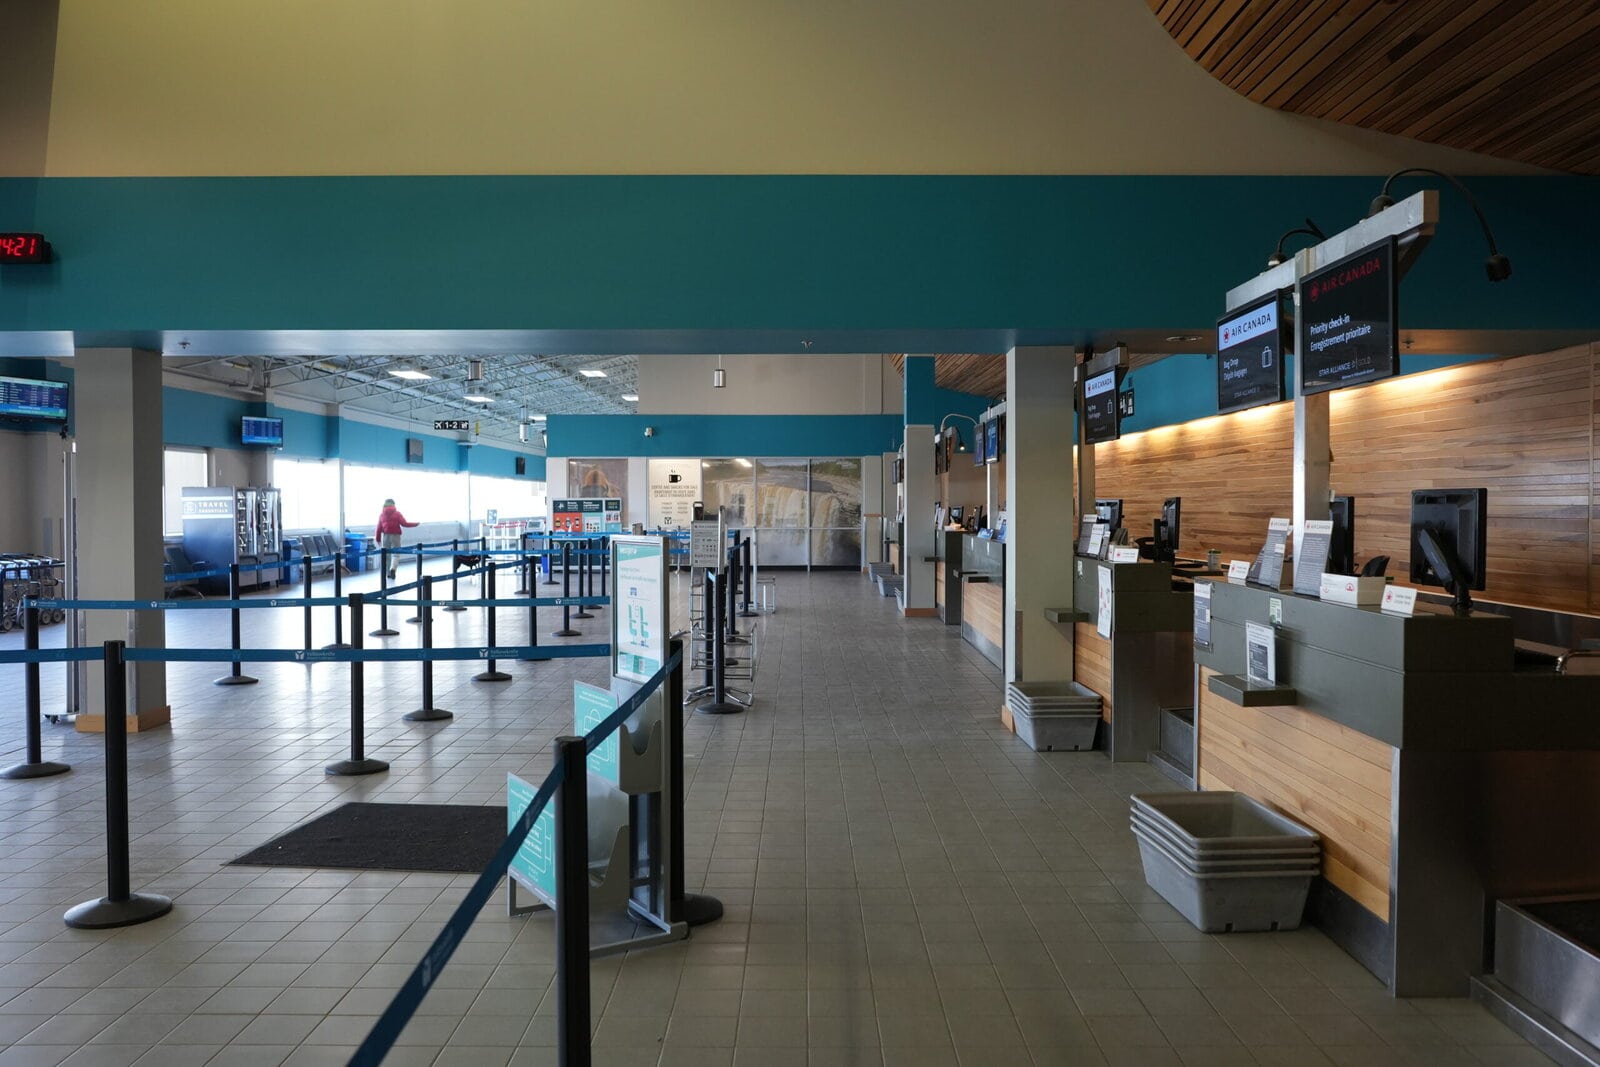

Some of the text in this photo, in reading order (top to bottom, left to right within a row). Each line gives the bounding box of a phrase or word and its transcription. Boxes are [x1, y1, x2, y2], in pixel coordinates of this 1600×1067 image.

[1322, 258, 1380, 293] AIR CANADA
[1231, 313, 1271, 337] AIR CANADA
[1310, 313, 1350, 336] Priority check-in
[1310, 324, 1372, 351] Enregistrement prioritaire
[1319, 368, 1330, 377] STAR
[1330, 361, 1351, 374] ALLIANCE
[444, 421, 458, 429] 1-2
